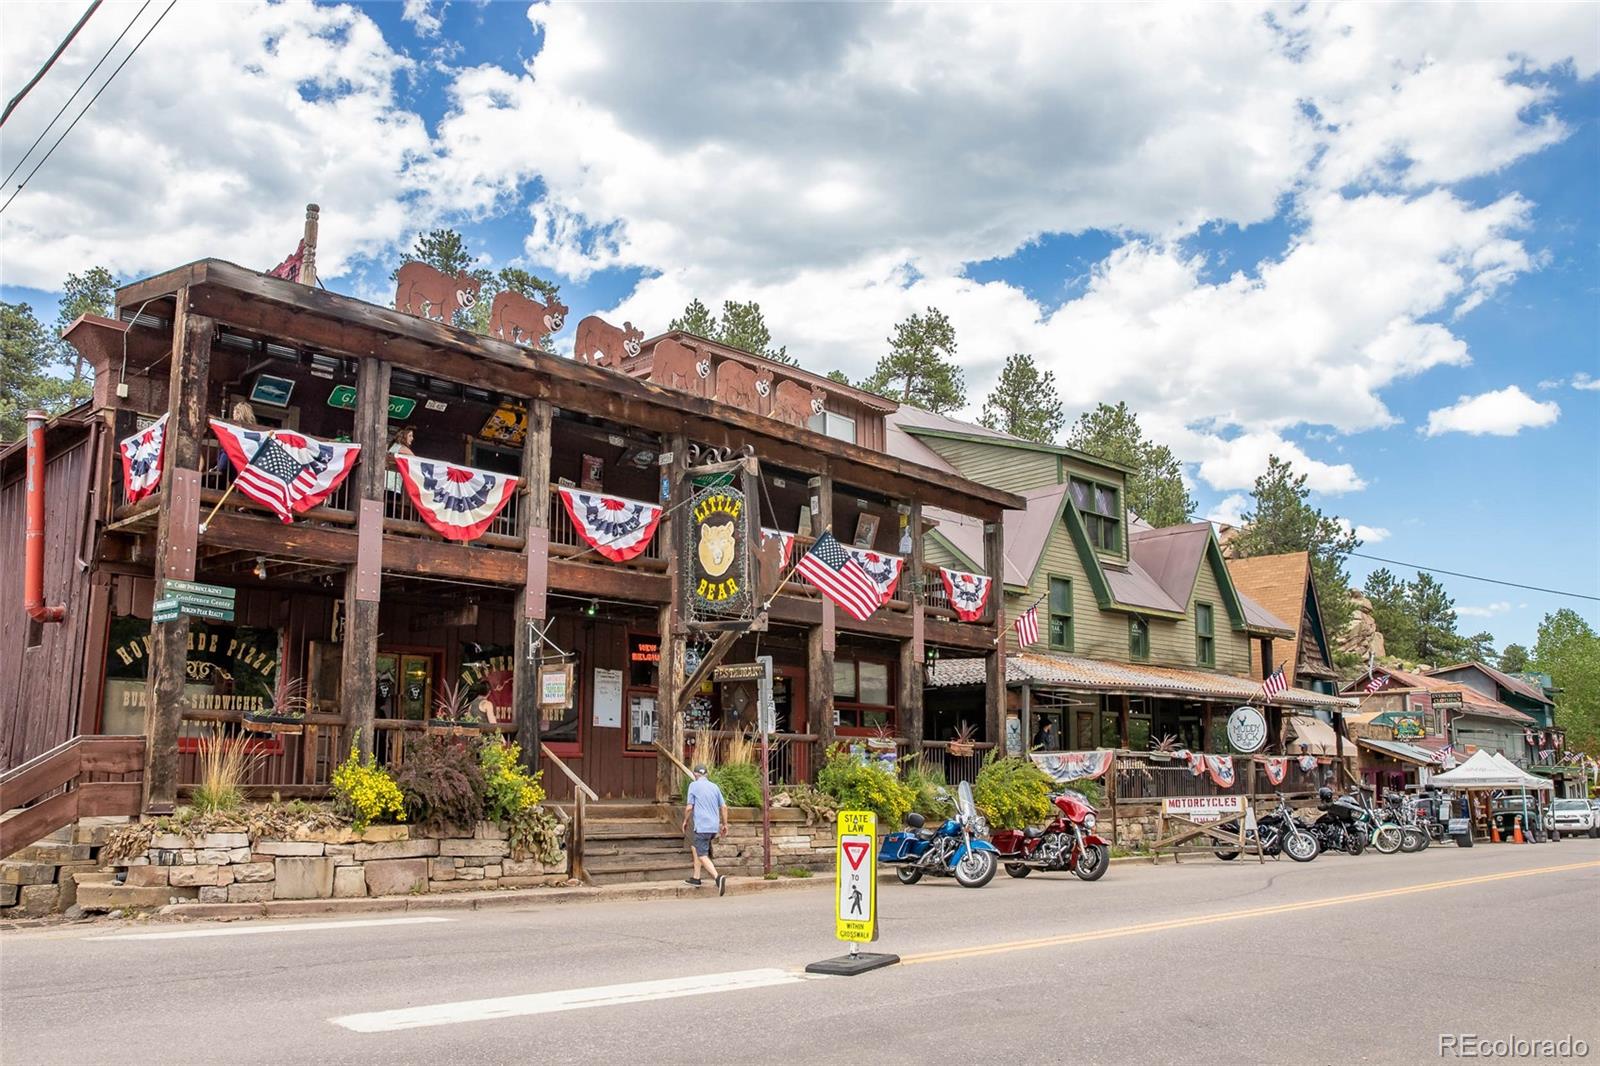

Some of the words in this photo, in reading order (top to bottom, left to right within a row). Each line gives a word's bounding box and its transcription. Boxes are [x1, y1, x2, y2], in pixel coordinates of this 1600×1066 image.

[694, 495, 742, 522] LITTLE
[697, 578, 739, 601] BEAR
[176, 594, 210, 604] Conference
[211, 599, 231, 607] Center
[638, 643, 657, 652] NEW
[227, 639, 276, 676] PIZZA
[631, 653, 661, 661] BELGIU
[191, 694, 264, 711] SANDWICHES
[1233, 724, 1260, 734] MUDDY
[1236, 732, 1259, 742] BUCK
[1168, 797, 1237, 808] MOTORCYCLES
[844, 814, 868, 823] STATE
[847, 824, 864, 833] LAW
[840, 930, 869, 939] CROSSWALK
